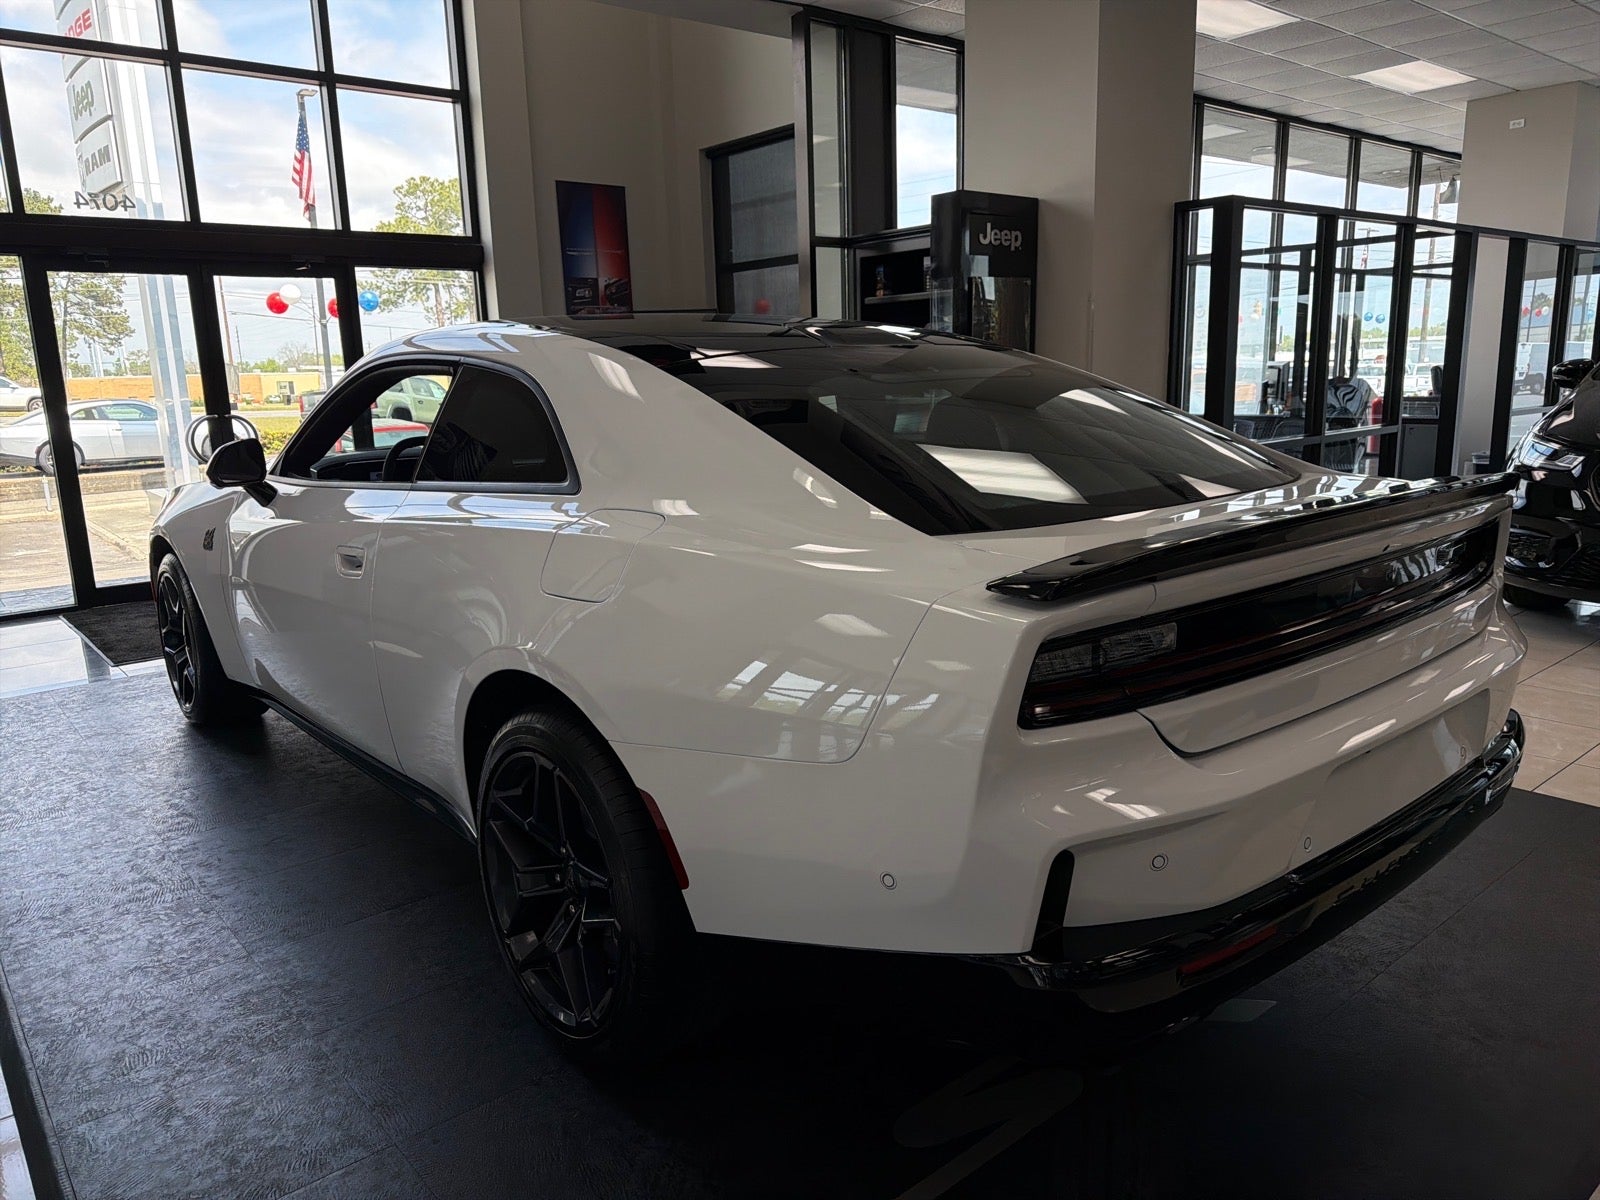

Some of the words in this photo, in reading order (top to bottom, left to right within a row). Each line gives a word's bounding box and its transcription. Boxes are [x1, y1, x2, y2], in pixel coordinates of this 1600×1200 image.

[72, 80, 95, 122] Jeep
[84, 144, 111, 177] RAM
[979, 222, 1022, 251] Jeep
